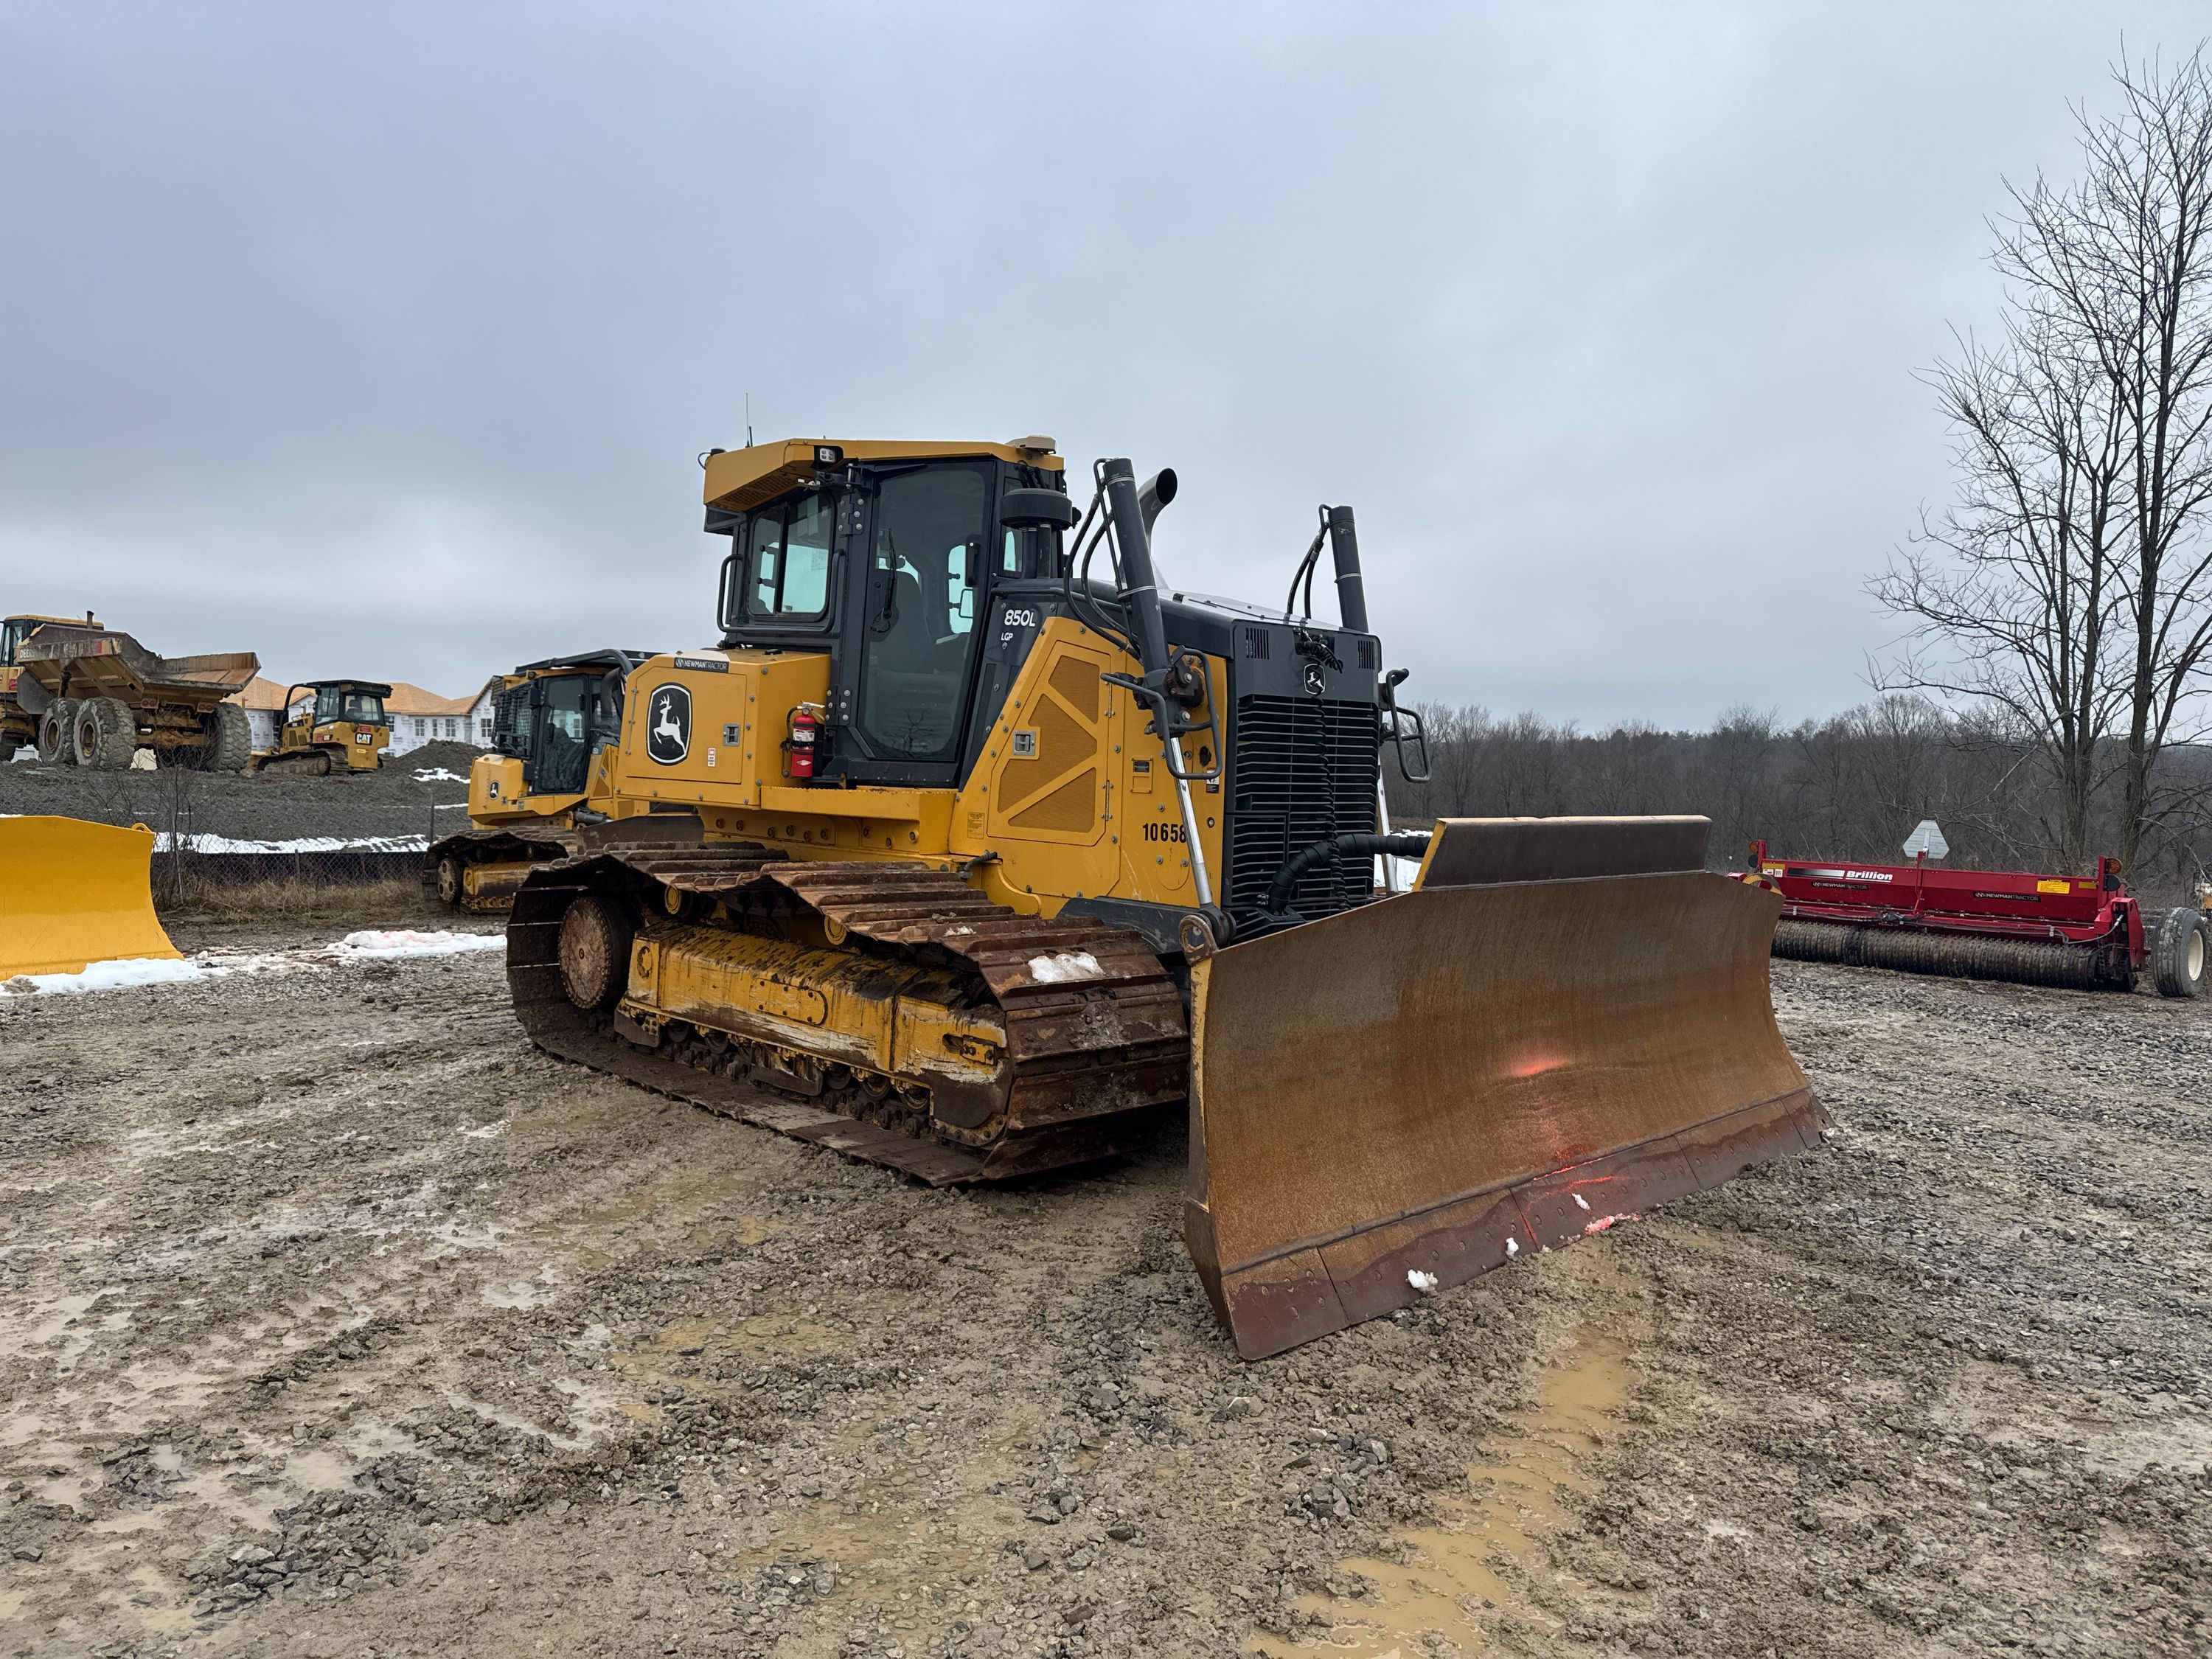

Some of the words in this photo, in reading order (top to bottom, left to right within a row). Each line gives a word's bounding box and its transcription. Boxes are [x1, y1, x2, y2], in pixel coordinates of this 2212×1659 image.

[1004, 609, 1035, 627] 850L
[1001, 632, 1014, 641] LGP
[356, 733, 372, 745] CAT
[1142, 822, 1186, 844] 10658
[1846, 870, 1893, 881] Brillion
